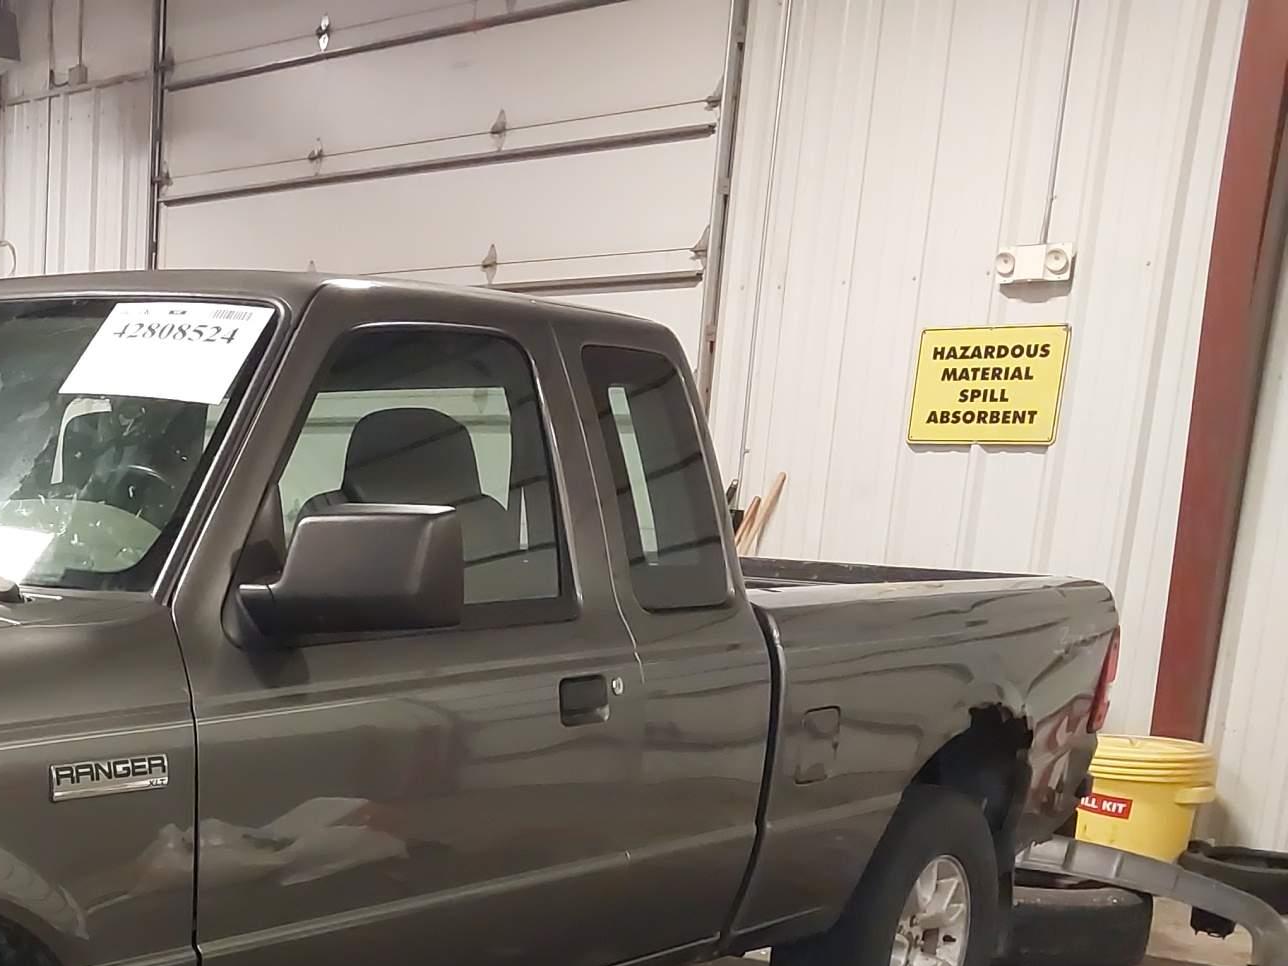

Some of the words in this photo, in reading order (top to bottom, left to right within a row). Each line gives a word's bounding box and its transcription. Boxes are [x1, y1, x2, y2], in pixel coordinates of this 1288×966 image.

[113, 322, 240, 344] 42808524
[932, 343, 1051, 360] HAZARDOUS
[941, 366, 1034, 382] MATERIAL
[958, 388, 1009, 403] SPILL
[925, 410, 1038, 425] ABSORBENT
[54, 755, 167, 786] RANGER
[1102, 800, 1127, 814] KIT
